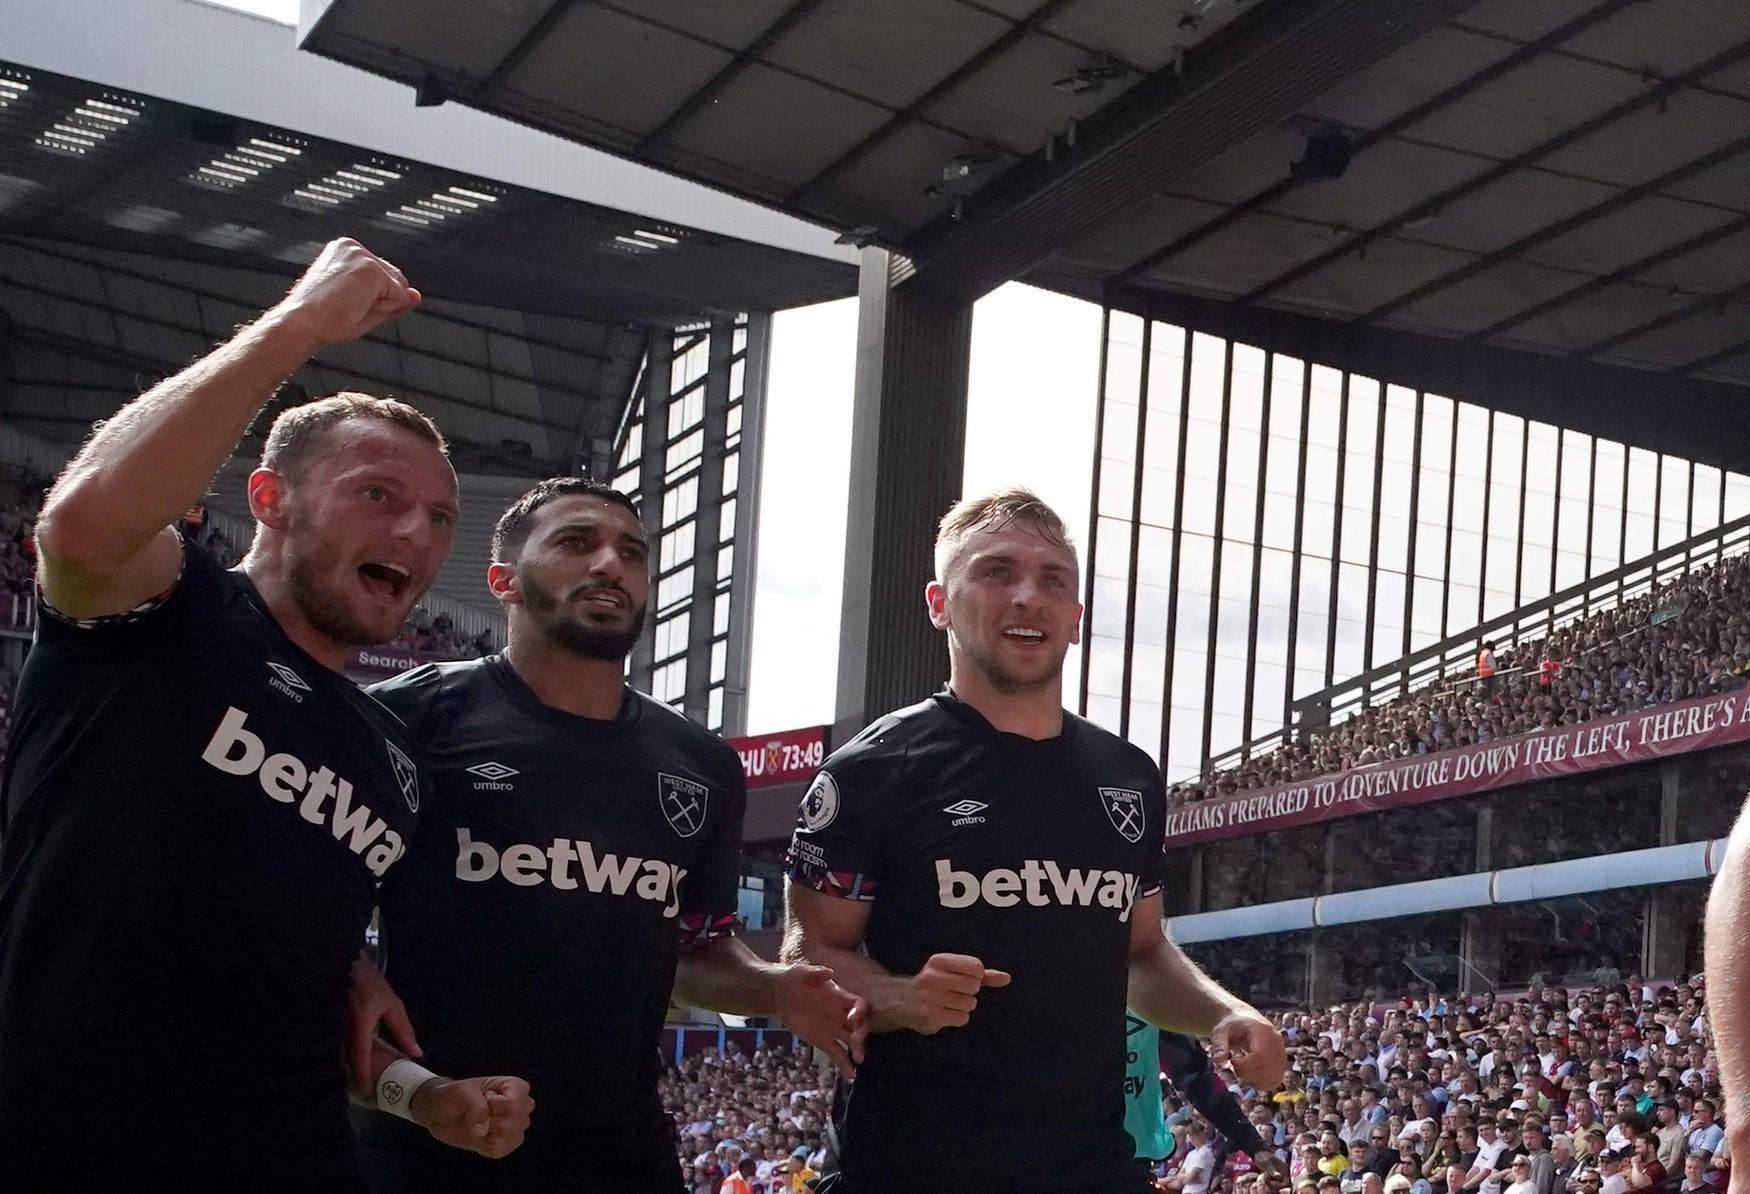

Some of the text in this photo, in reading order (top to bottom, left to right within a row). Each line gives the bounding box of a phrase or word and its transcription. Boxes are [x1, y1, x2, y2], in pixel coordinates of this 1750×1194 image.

[359, 650, 419, 670] Search
[268, 676, 304, 703] umbro
[782, 741, 824, 771] 73:49
[1165, 803, 1225, 837] ILLIAMS
[1229, 787, 1309, 826] PREPARED
[1313, 783, 1336, 807] TO
[1337, 758, 1453, 803] ADVENTURE
[1454, 742, 1522, 782] DOWN
[1524, 734, 1569, 766] THE
[1572, 721, 1632, 758] LEFT,
[1638, 697, 1738, 746] THERE'S
[202, 706, 406, 888] betwa
[473, 781, 514, 791] umbro
[951, 815, 986, 827] umbro
[456, 827, 688, 918] betway
[935, 859, 1140, 923] betway
